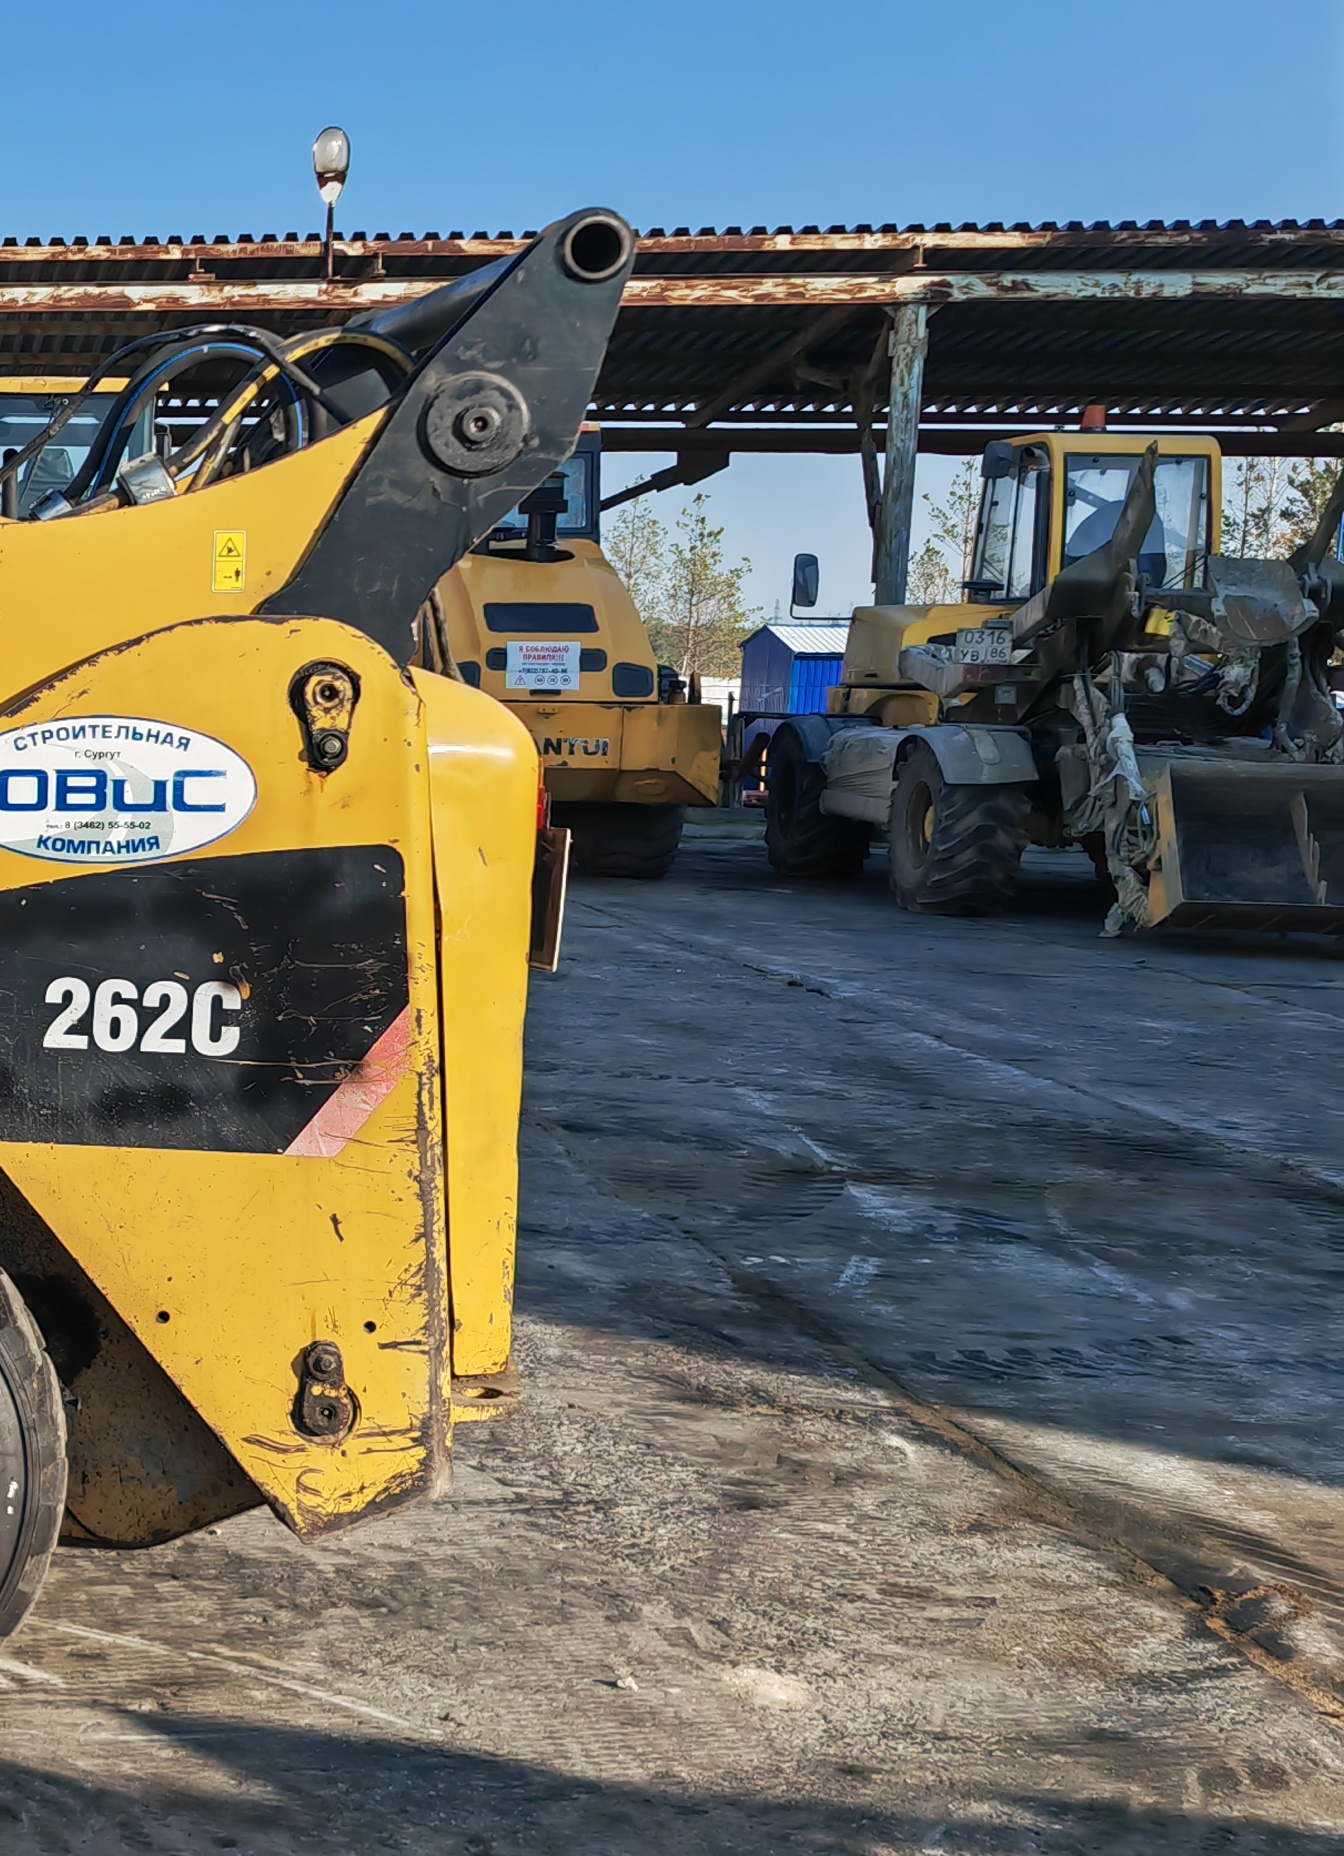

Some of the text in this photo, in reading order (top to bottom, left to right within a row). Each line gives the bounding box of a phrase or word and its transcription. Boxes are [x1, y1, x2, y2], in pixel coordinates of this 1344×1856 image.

[964, 630, 1006, 645] 0316
[990, 647, 1007, 659] 86
[13, 724, 192, 752] СТРОИТЕЛЬНАЯ
[84, 749, 122, 760] Сургут
[64, 820, 71, 829] 8
[73, 820, 105, 831] (3462)
[107, 820, 152, 830] 55-55-02
[35, 834, 161, 855] КОМПАНИЯ
[42, 976, 243, 1057] 262C
